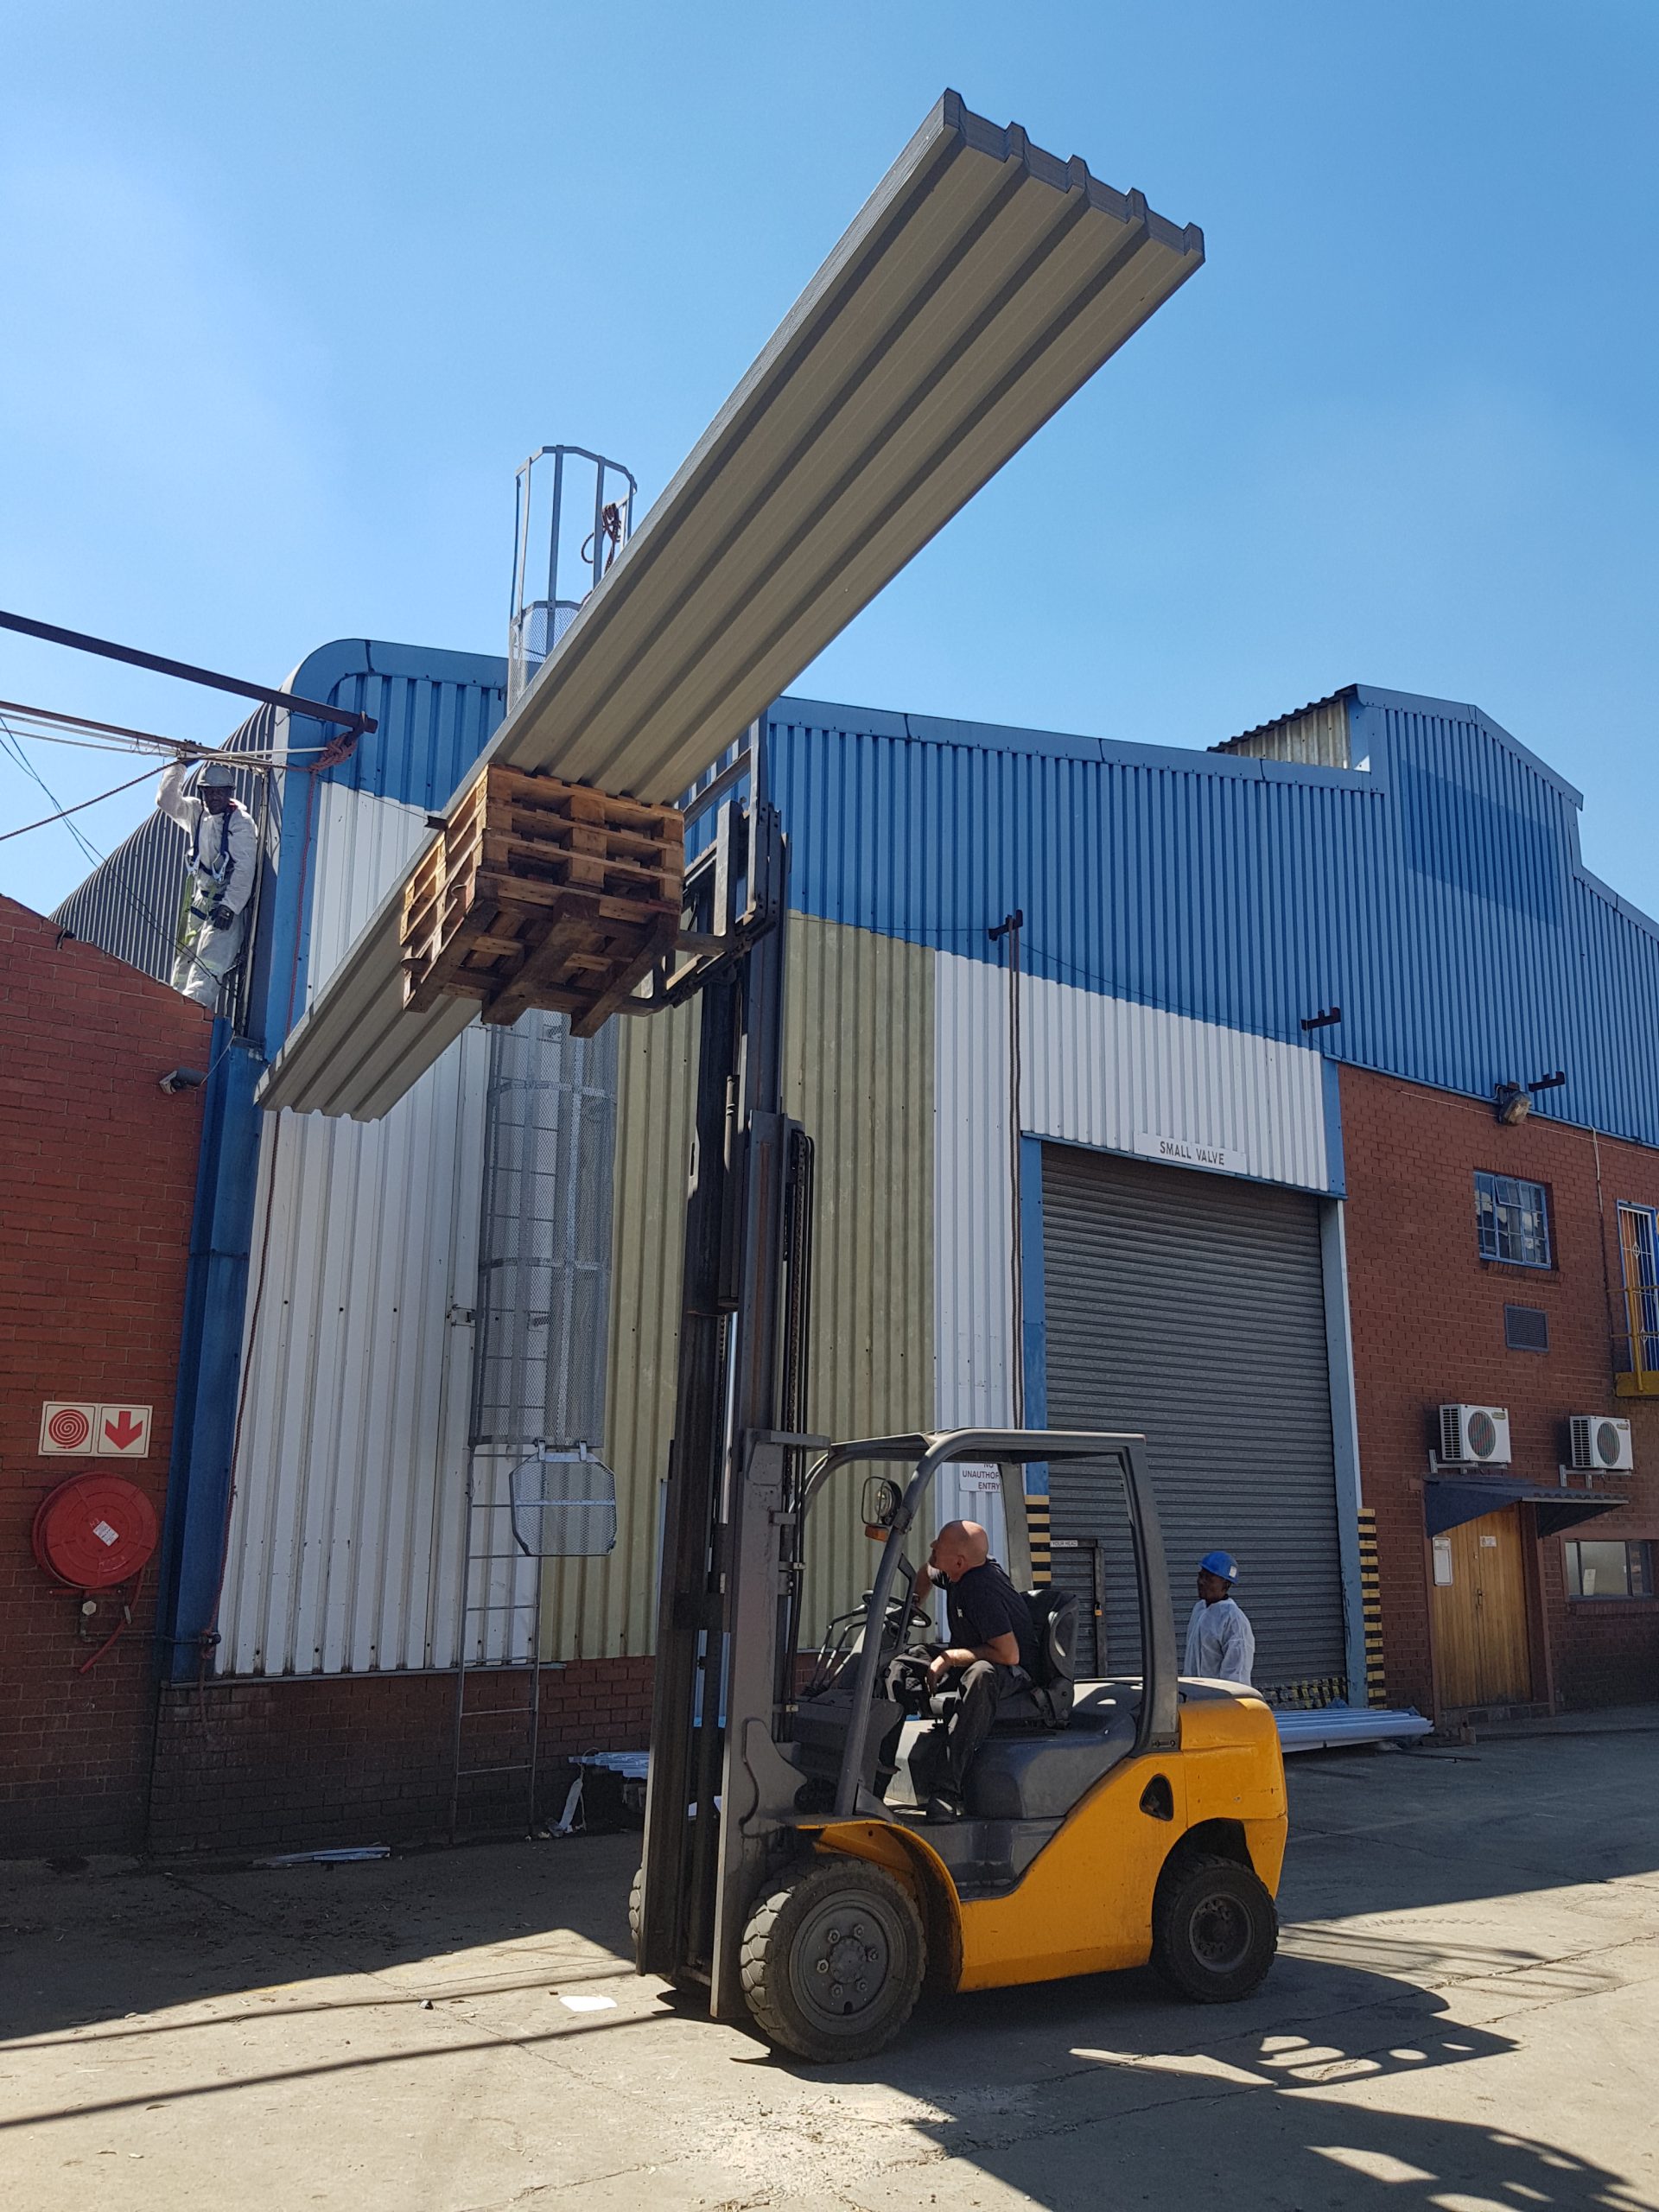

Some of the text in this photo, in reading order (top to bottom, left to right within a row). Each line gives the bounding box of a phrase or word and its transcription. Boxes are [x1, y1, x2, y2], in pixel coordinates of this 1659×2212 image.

[1160, 1141, 1225, 1166] SMALL VALVE
[978, 1481, 1001, 1491] ENTRY
